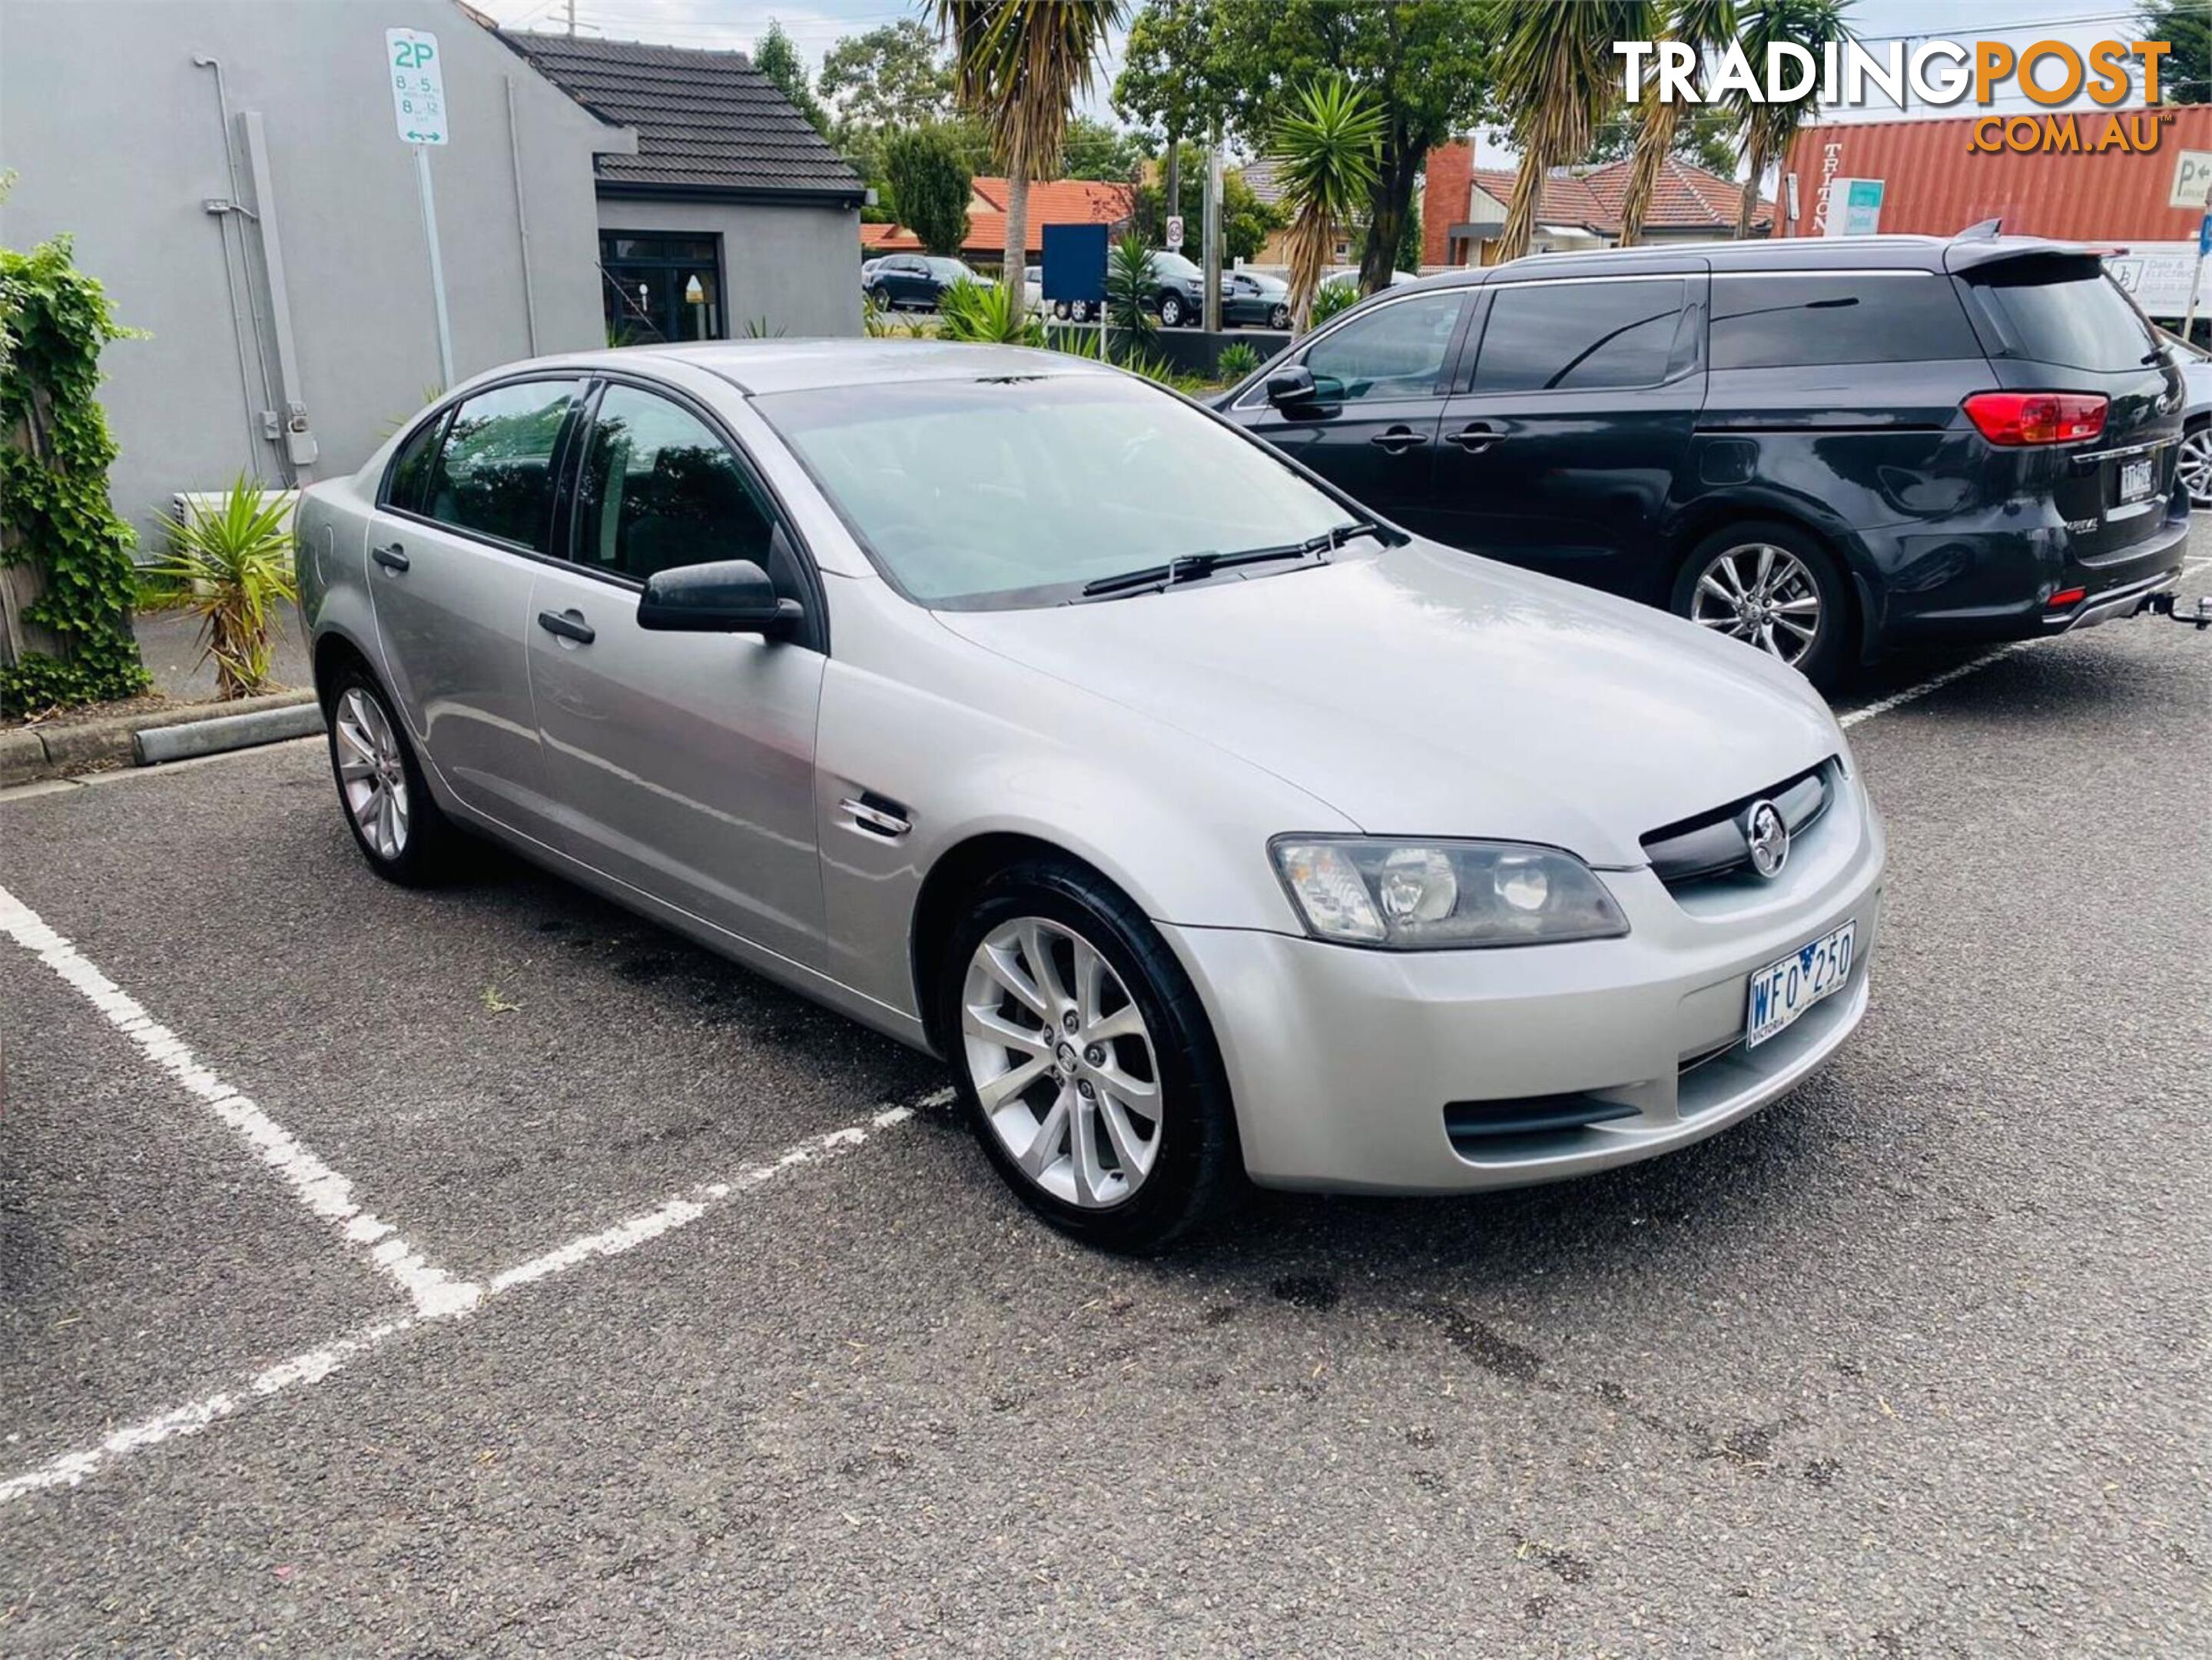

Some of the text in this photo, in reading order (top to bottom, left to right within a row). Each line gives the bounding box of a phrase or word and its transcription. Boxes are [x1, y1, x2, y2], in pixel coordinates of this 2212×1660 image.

[394, 41, 433, 69] 2P
[396, 75, 431, 92] 8 5
[403, 100, 413, 114] 8
